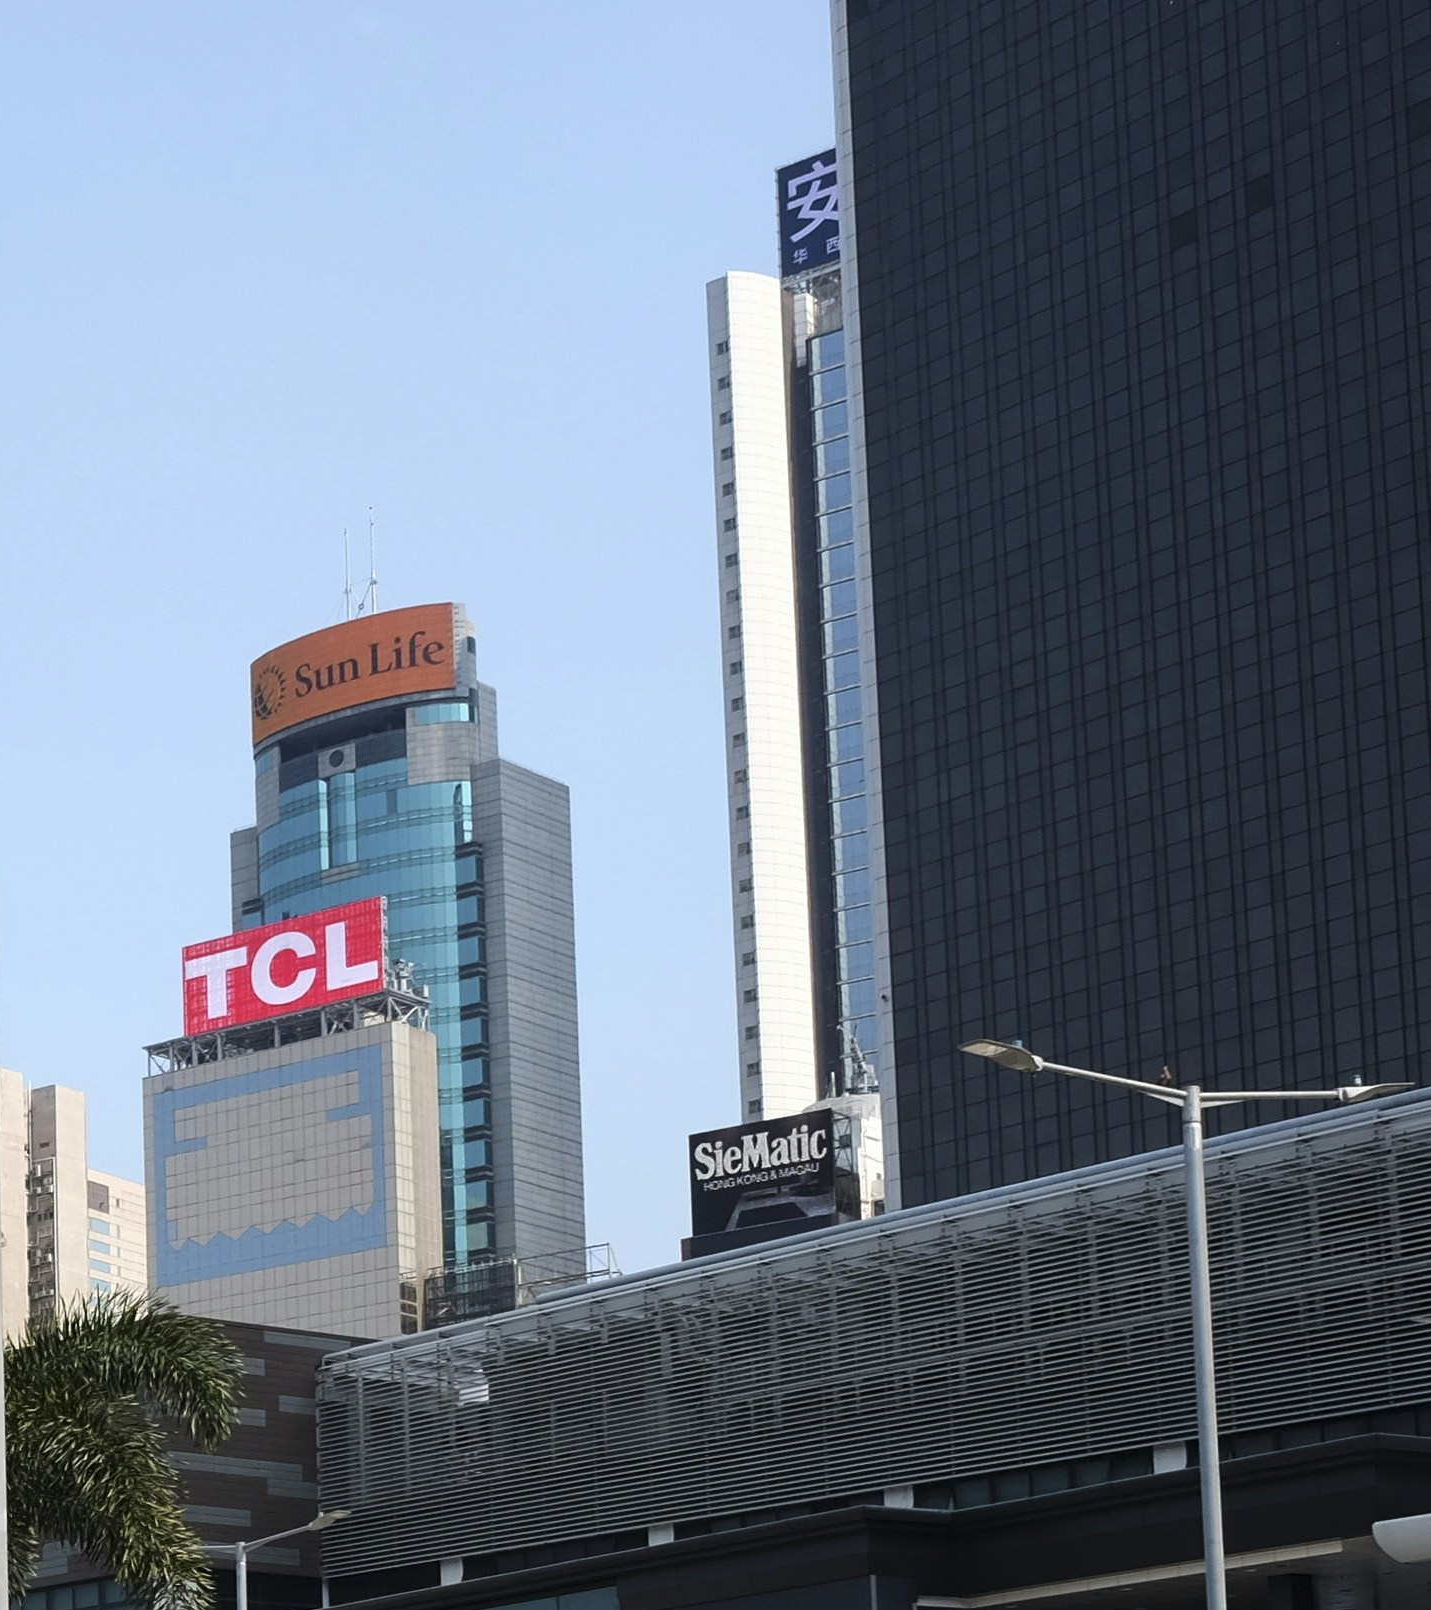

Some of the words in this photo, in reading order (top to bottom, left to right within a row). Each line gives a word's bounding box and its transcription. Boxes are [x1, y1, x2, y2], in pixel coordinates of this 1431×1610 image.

[786, 160, 839, 243] 安
[295, 657, 360, 698] Sun
[368, 631, 444, 676] Life
[185, 921, 379, 1020] TCL
[694, 1125, 827, 1180] SieMatic
[704, 1178, 735, 1191] HONG
[737, 1171, 769, 1186] KONG
[779, 1162, 819, 1178] MACAU
